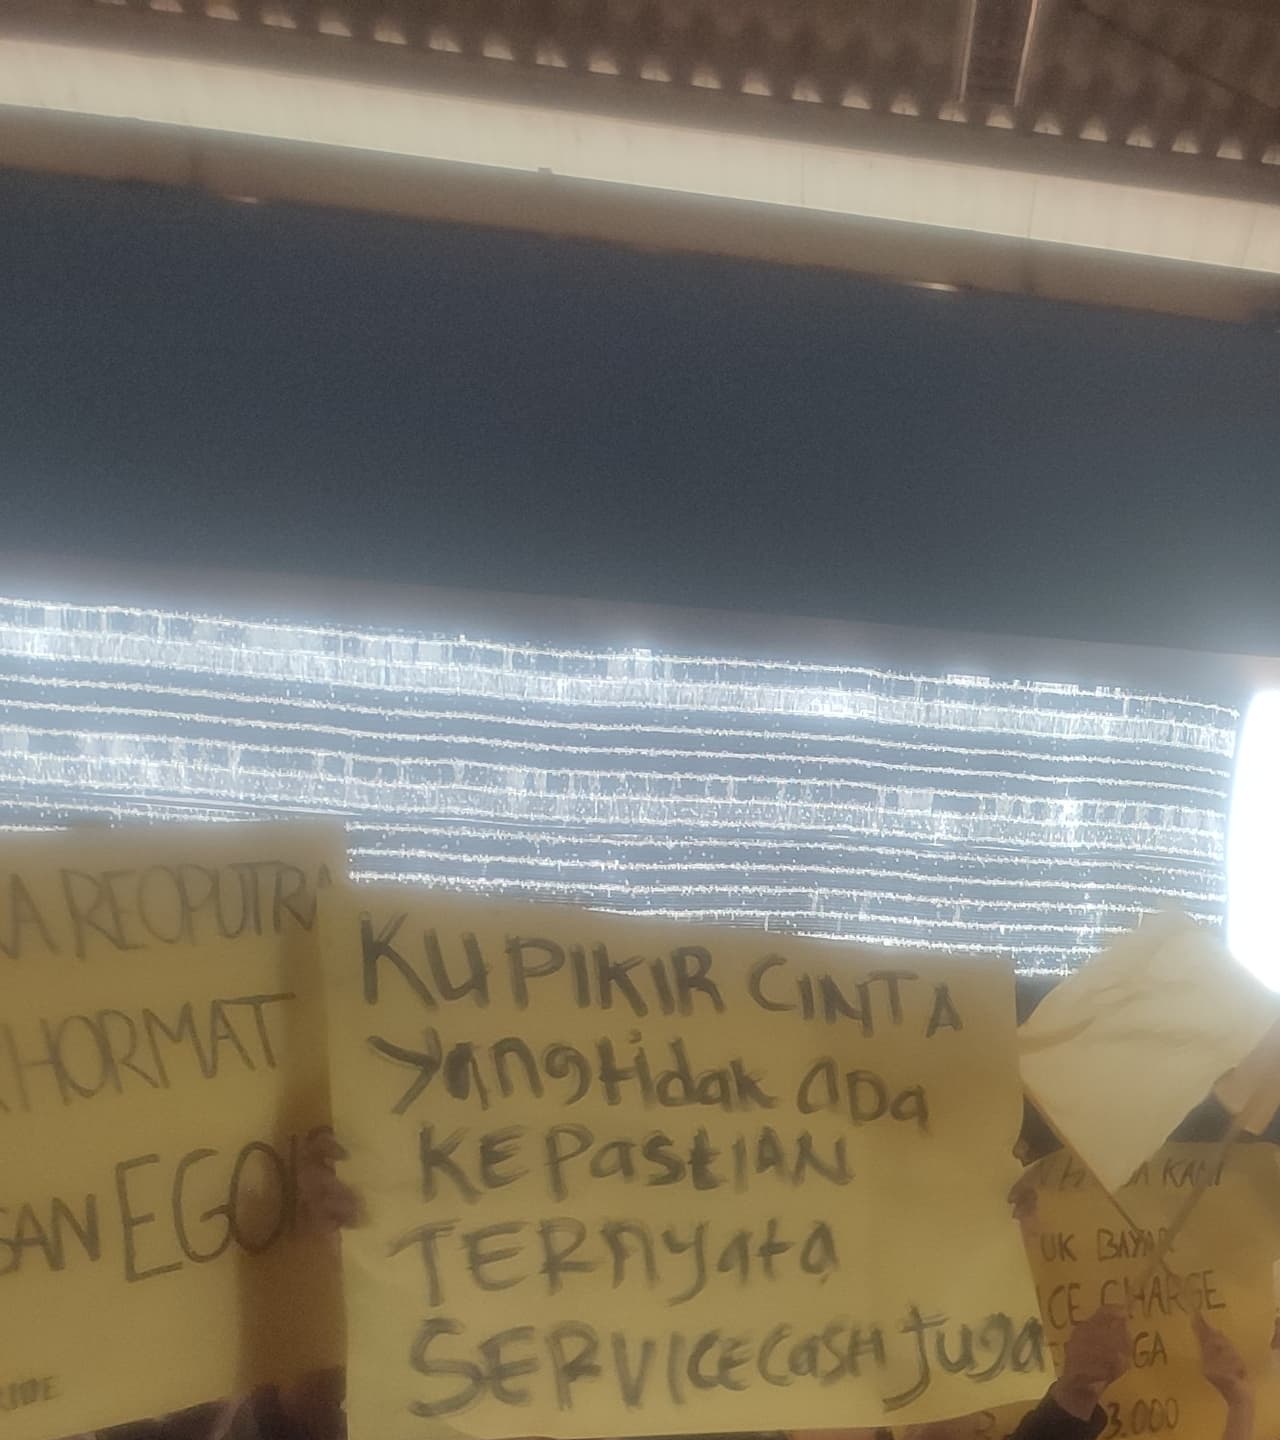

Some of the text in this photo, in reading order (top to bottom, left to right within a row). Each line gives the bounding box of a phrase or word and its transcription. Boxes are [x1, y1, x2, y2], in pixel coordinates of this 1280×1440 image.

[360, 910, 965, 1039] KU PIKIR CINTA
[408, 1316, 753, 1418] SERVICE
